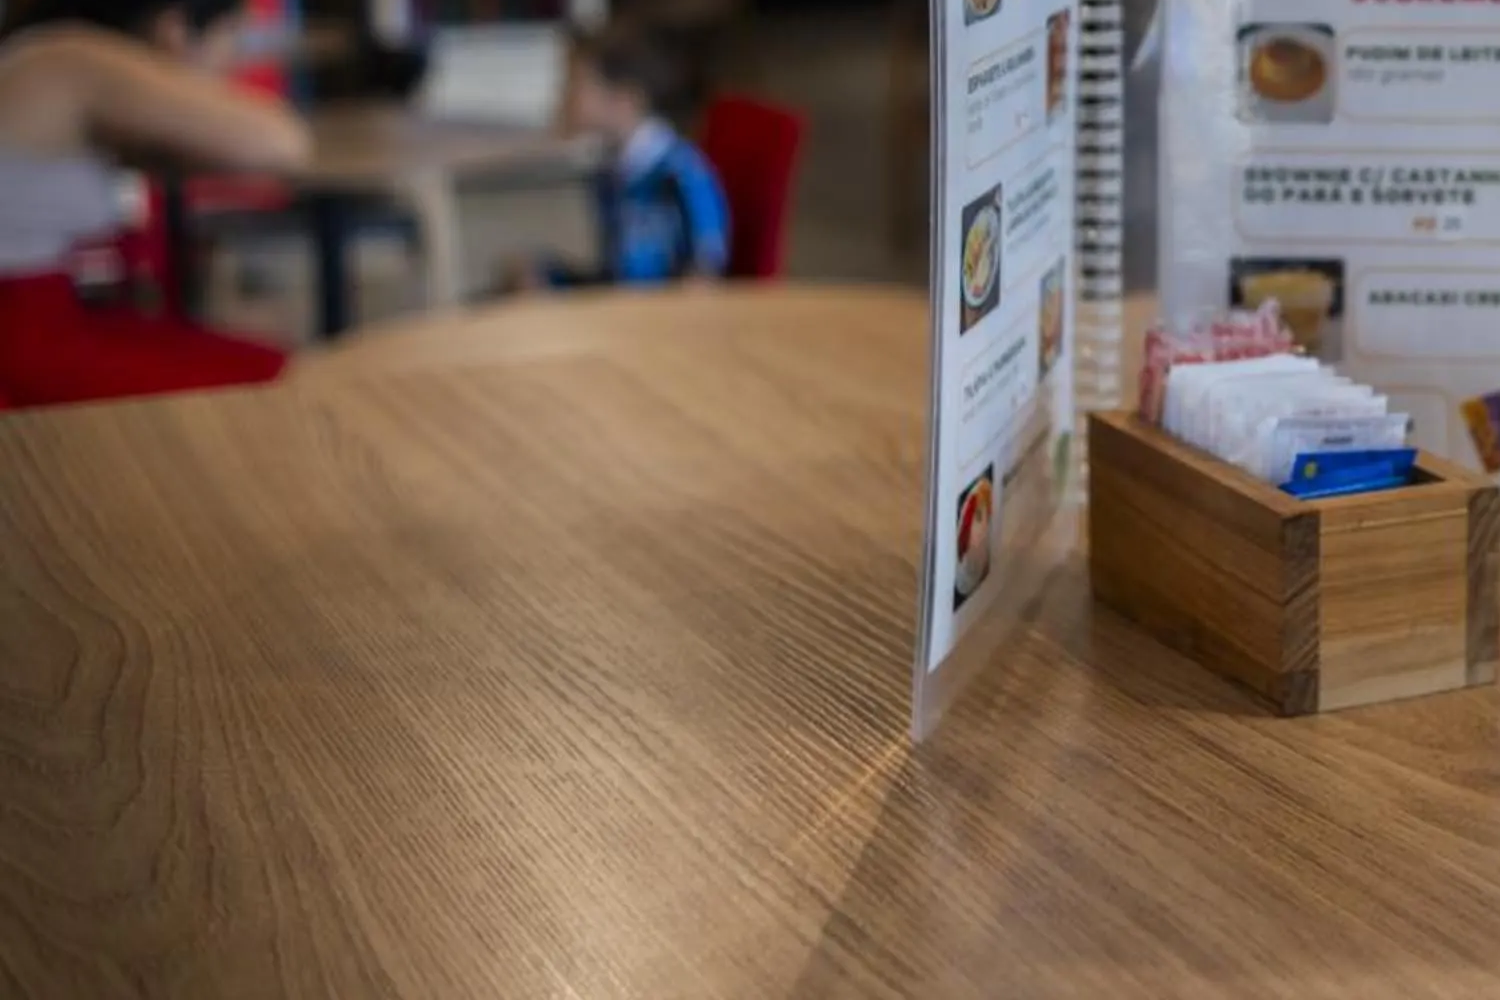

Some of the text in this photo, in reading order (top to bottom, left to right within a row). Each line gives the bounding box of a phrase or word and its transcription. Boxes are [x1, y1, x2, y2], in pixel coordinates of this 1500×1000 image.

[1346, 45, 1410, 60] PUDIM
[1417, 45, 1443, 60] DE
[1244, 167, 1350, 183] BROWNIE
[1244, 187, 1276, 204] DO
[1372, 186, 1475, 205] SORVETE
[1368, 290, 1457, 305] ABACAXI
